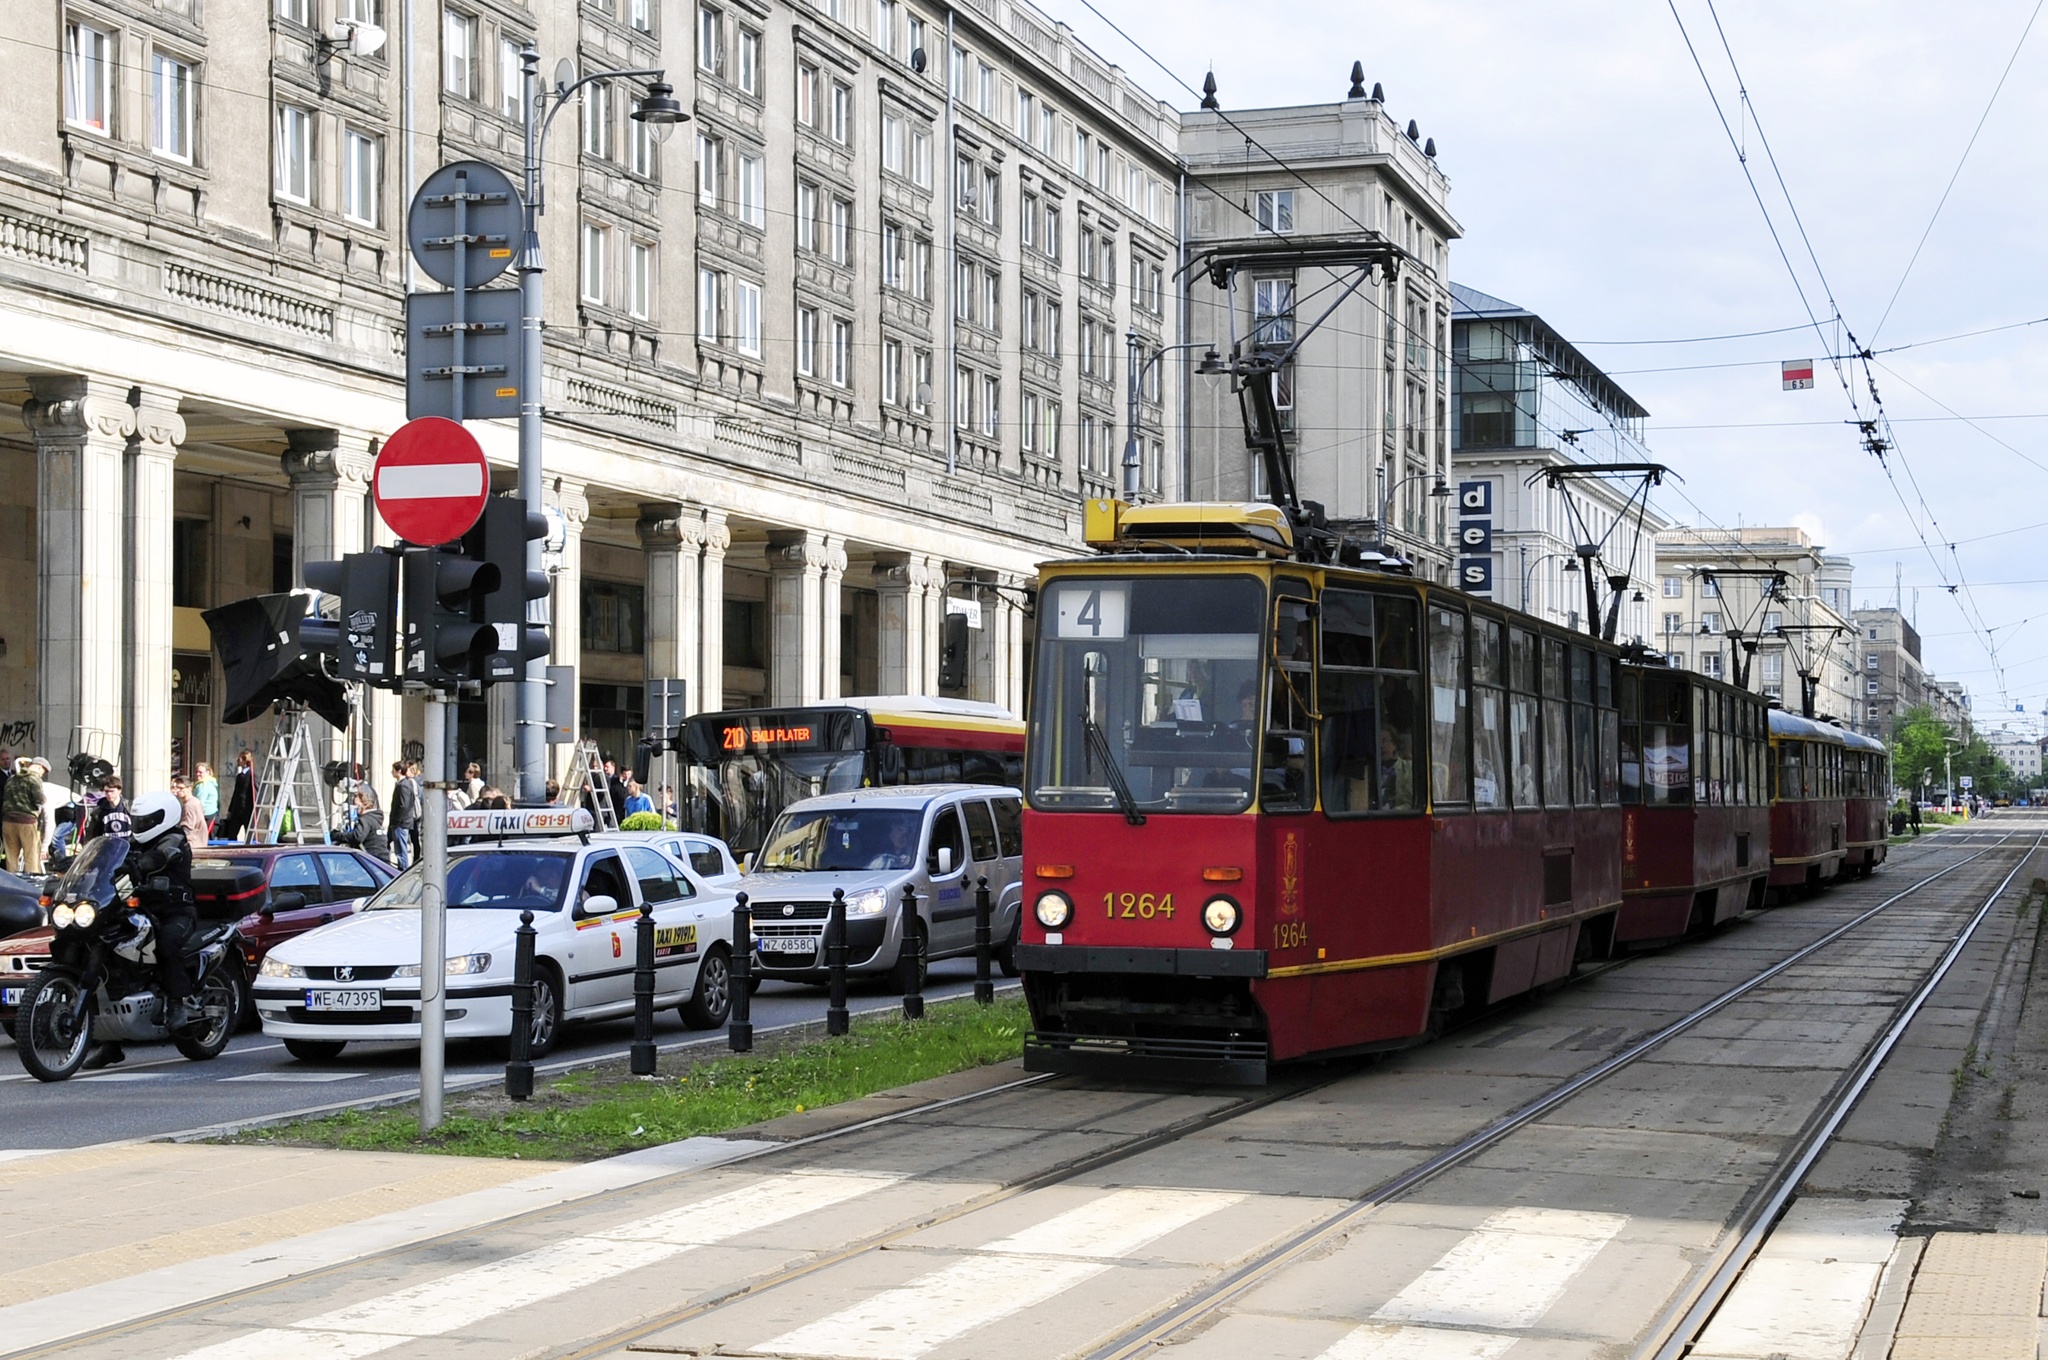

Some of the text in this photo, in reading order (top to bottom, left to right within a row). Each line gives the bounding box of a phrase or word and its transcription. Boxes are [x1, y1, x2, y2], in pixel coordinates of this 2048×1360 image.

[1792, 379, 1804, 389] 65
[1077, 590, 1102, 636] 4
[723, 727, 745, 749] 210
[777, 727, 810, 741] PLATER
[447, 814, 571, 829] MPT TAXI 191-91
[1103, 892, 1175, 919] 1264
[656, 925, 691, 945] TAXI 19191
[763, 939, 813, 950] WZ 6858C
[1273, 922, 1308, 949] 1264
[314, 991, 377, 1006] WE 47395
